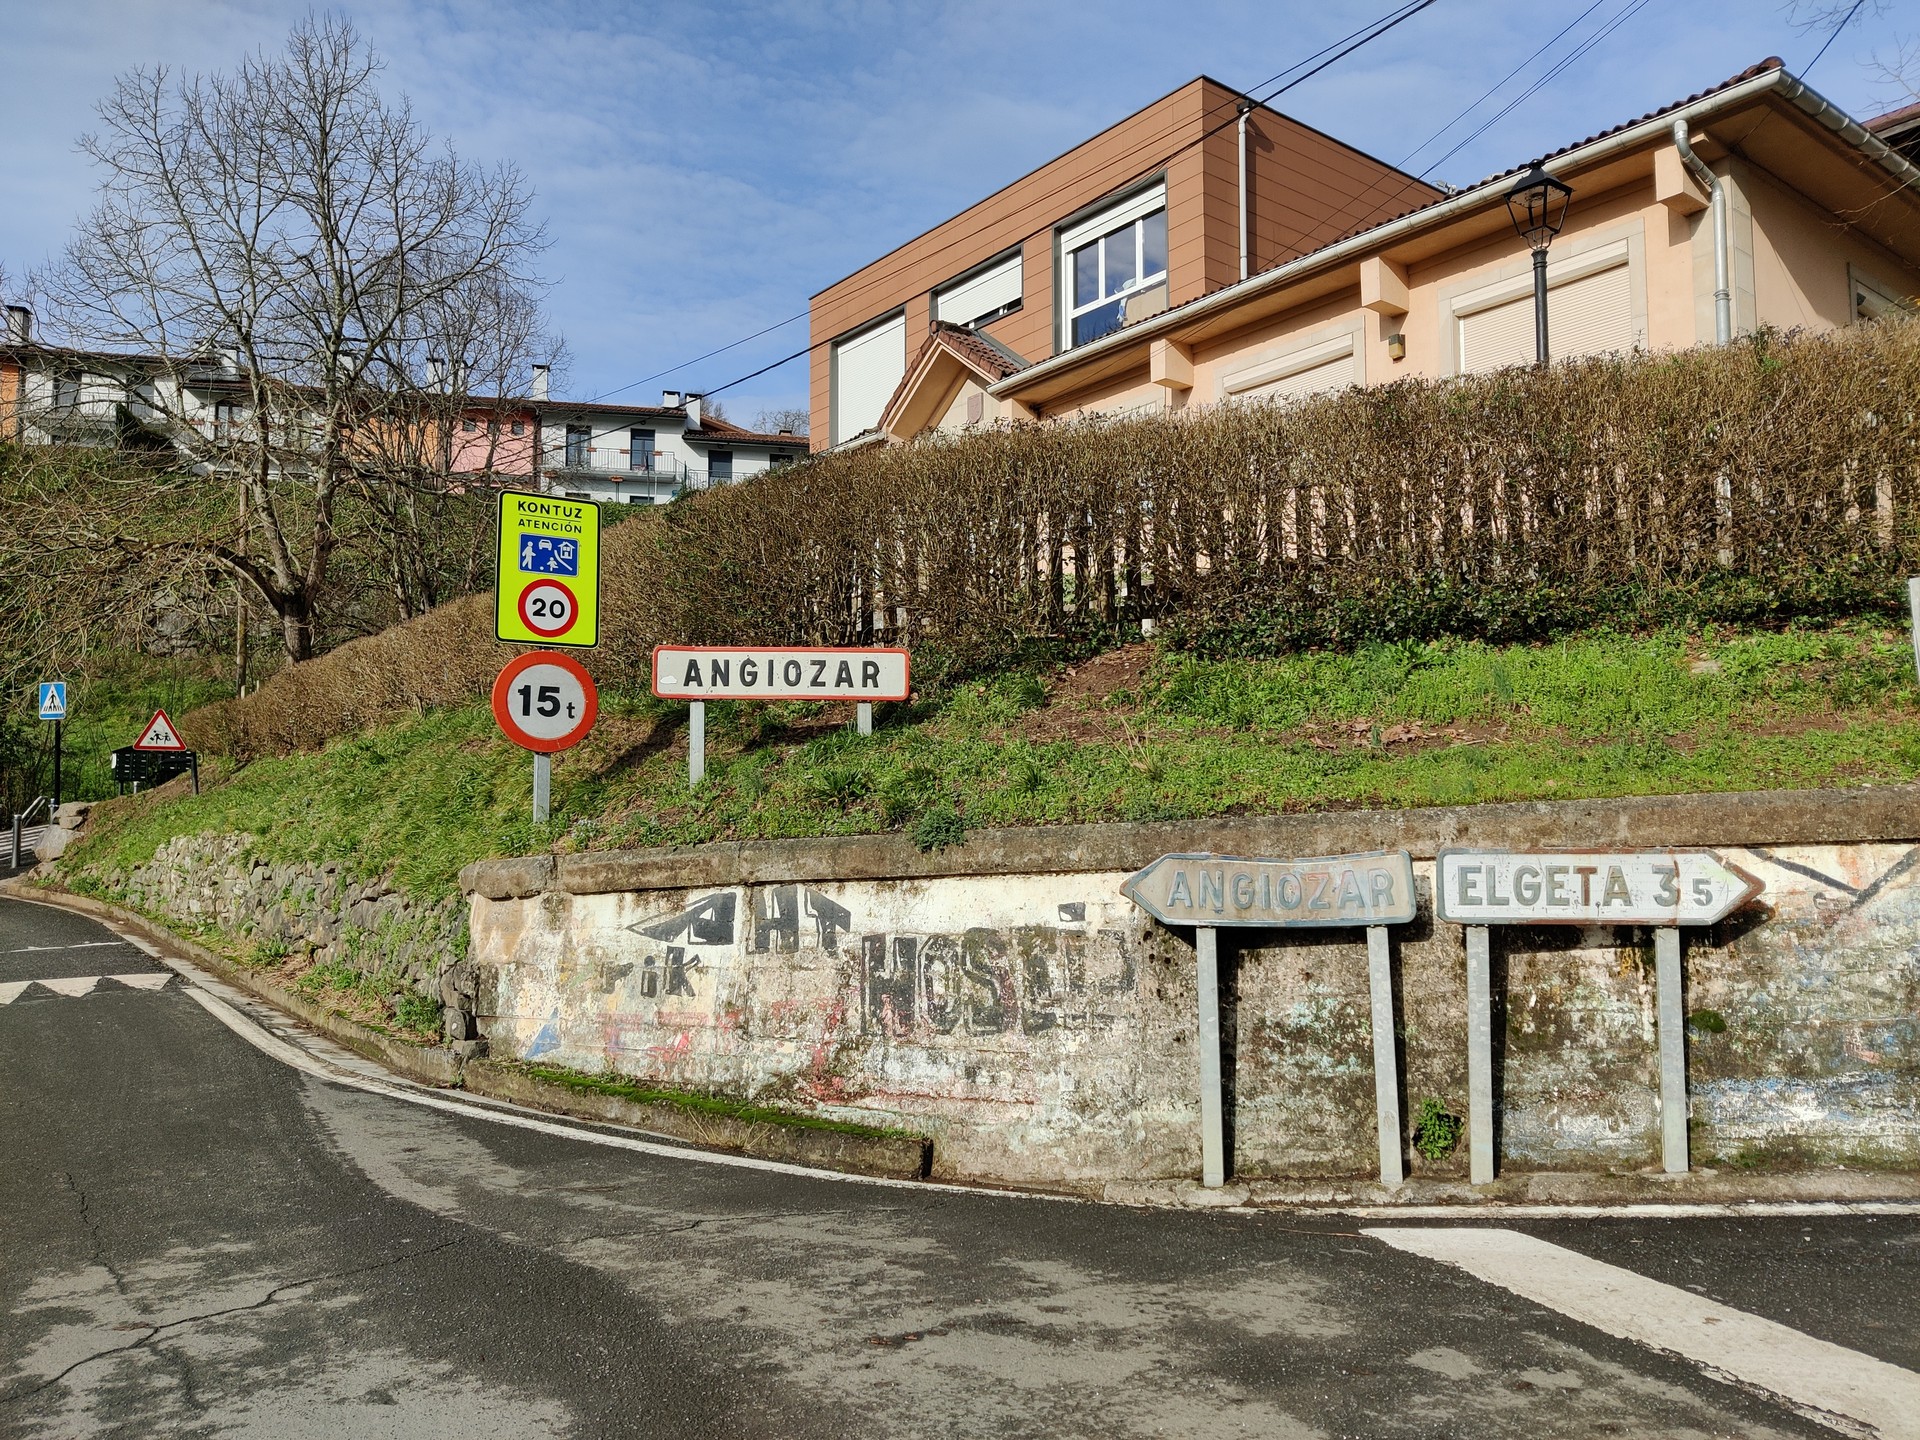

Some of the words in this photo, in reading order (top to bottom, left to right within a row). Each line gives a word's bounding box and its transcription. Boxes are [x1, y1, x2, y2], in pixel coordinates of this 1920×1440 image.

[517, 500, 583, 519] KONTUZ
[517, 518, 582, 533] ATENCIÓN
[531, 598, 566, 619] 20
[683, 657, 881, 688] ANGIOZAR
[1166, 868, 1396, 911] ANGIOZAR
[1457, 864, 1633, 907] ELGETA
